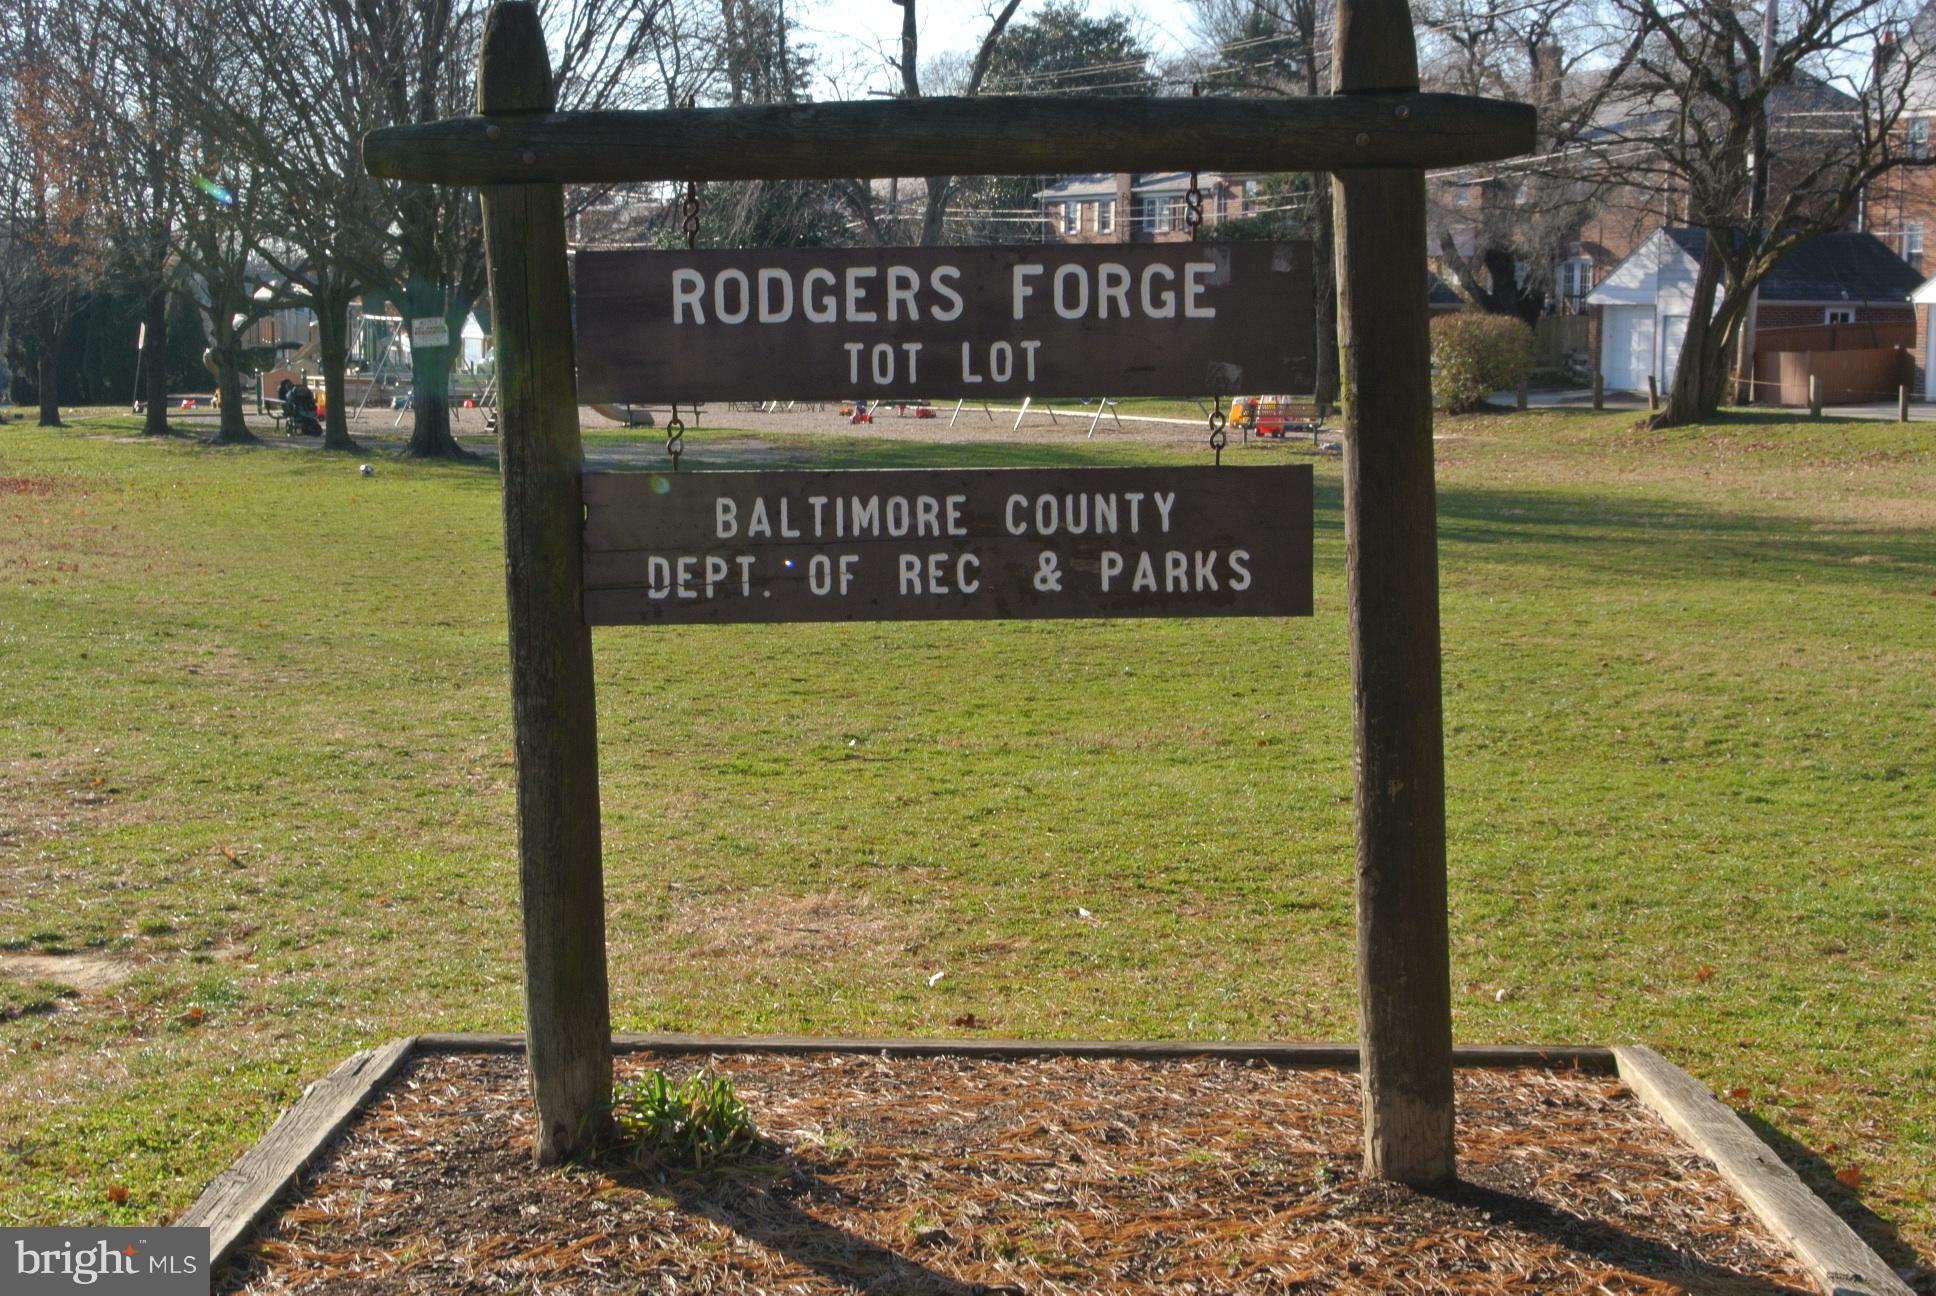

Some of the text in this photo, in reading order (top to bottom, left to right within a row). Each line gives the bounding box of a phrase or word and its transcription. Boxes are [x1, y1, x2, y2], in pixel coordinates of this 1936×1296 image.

[672, 262, 1217, 325] RODGERS FORGE
[844, 340, 1042, 384] TOT LOT
[715, 492, 1176, 539] BALTIMORE COUNTY
[647, 550, 1252, 600] DEPT. OF REC & PARKS
